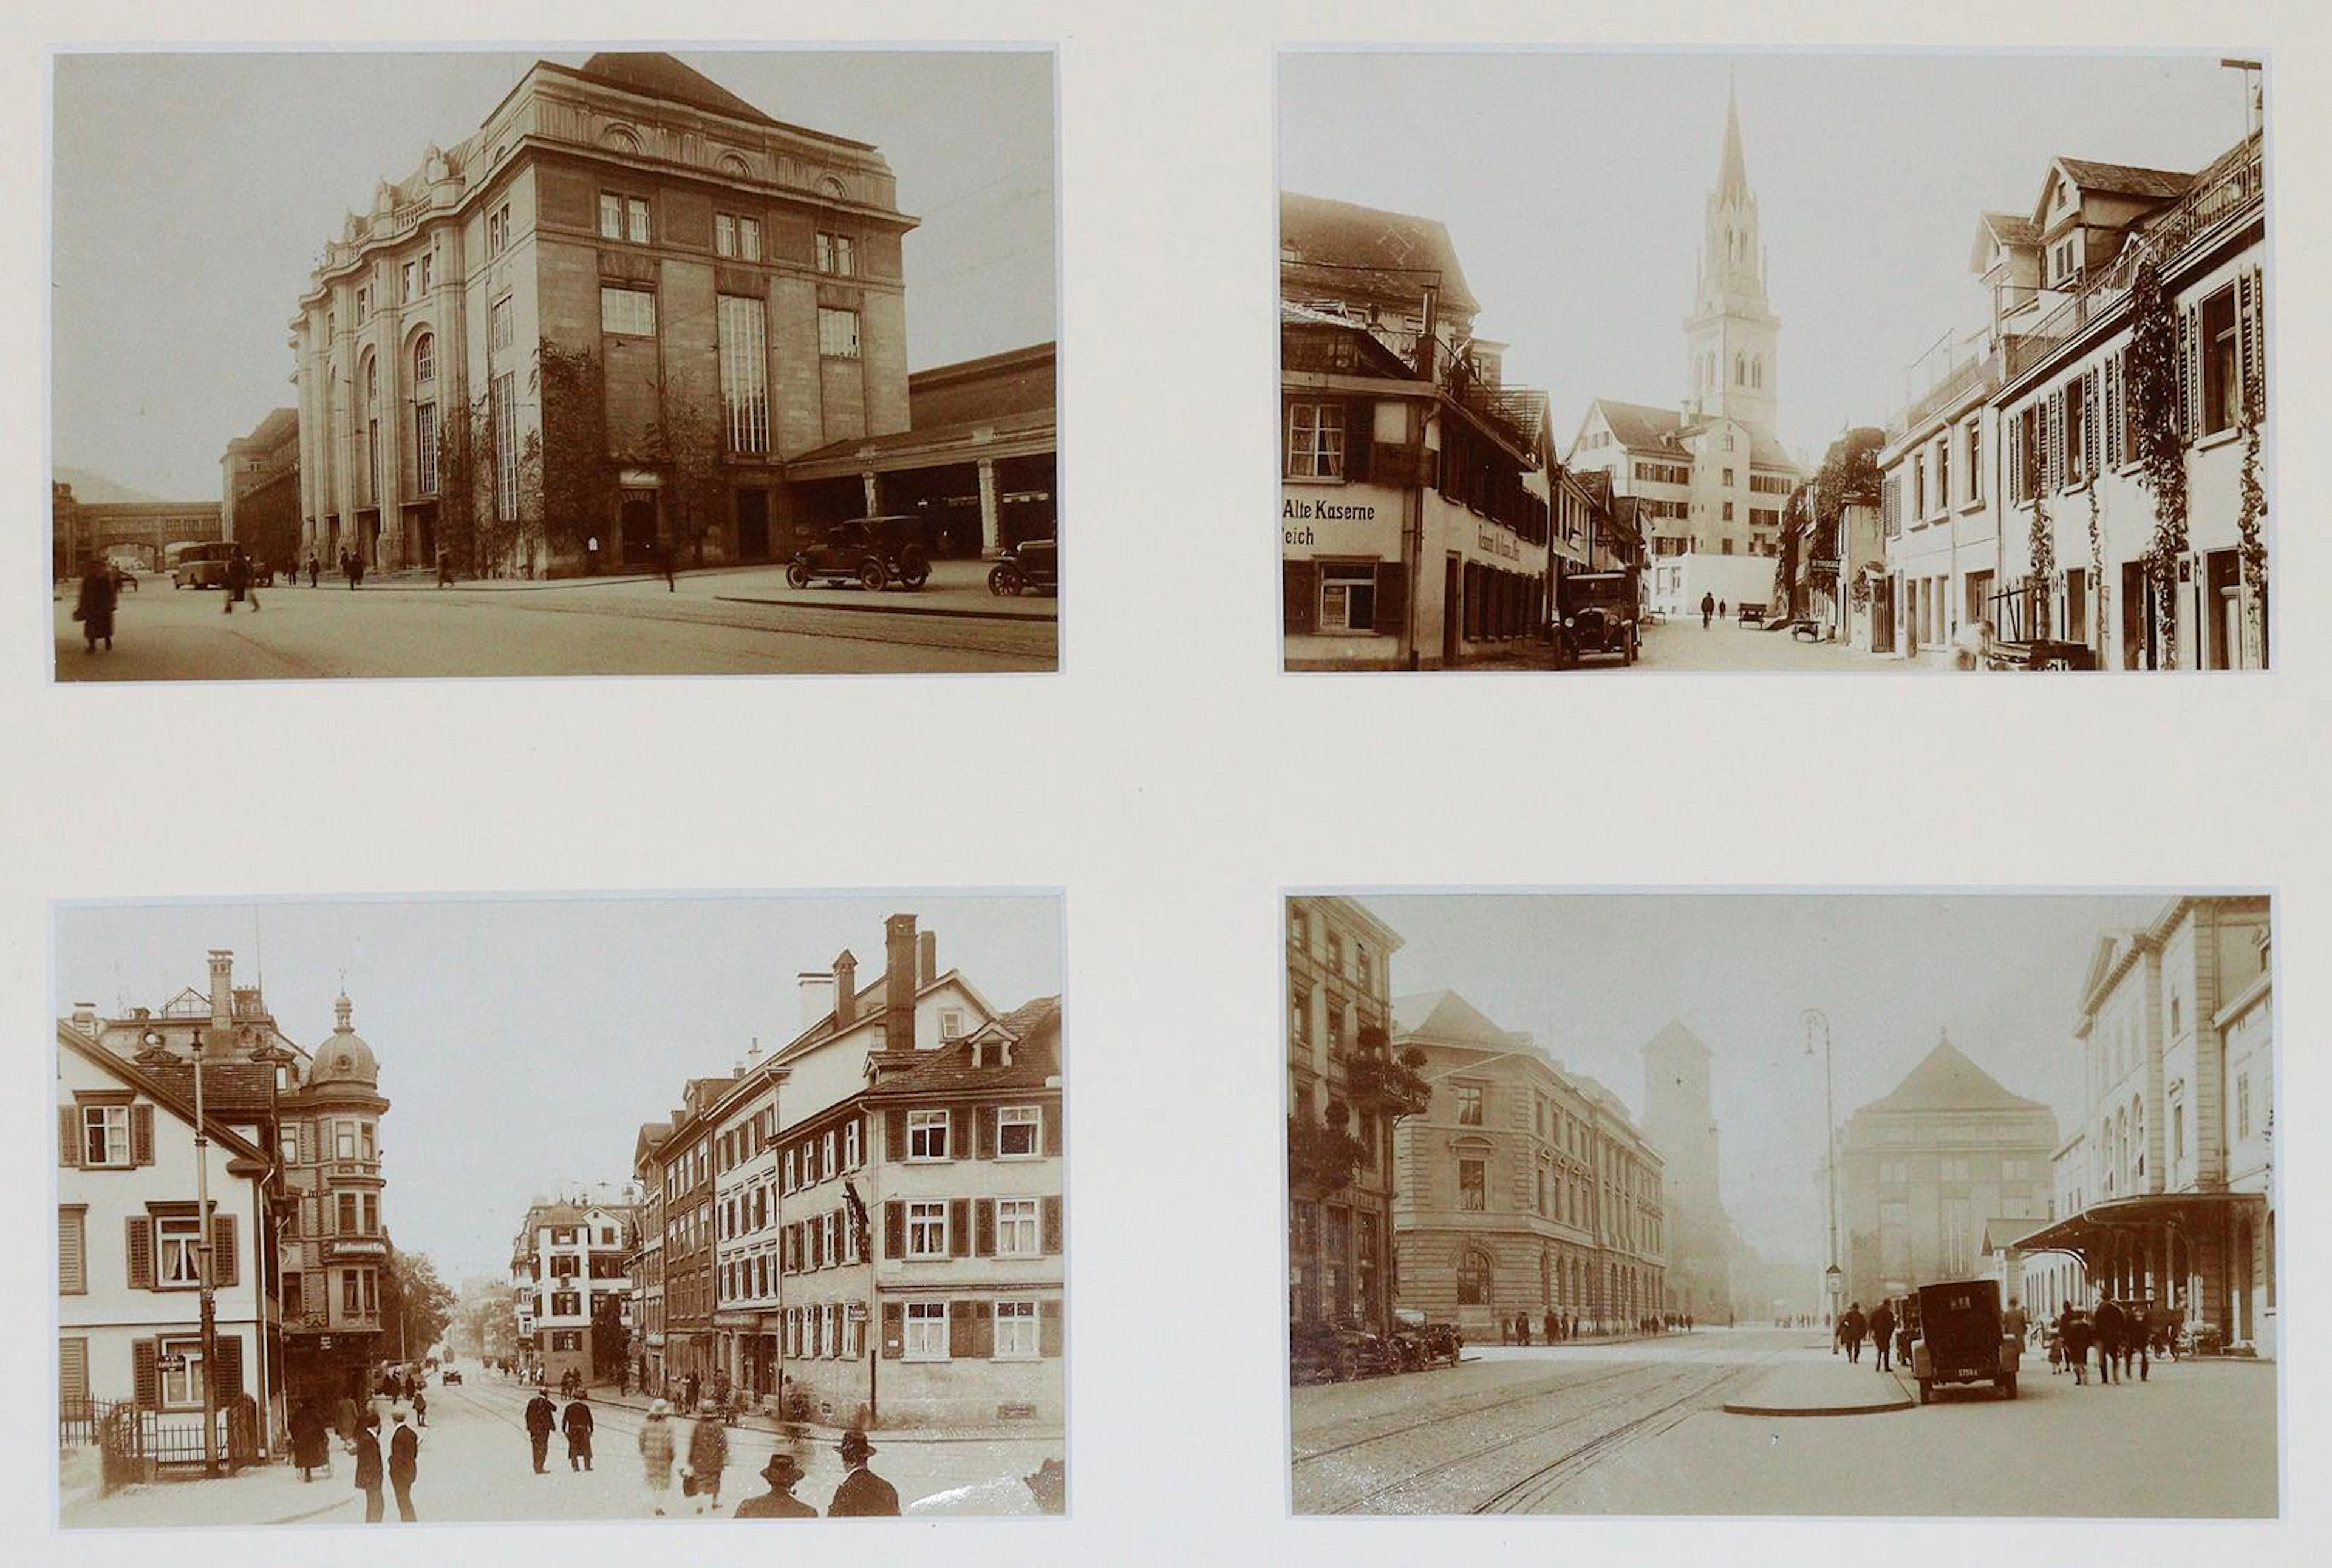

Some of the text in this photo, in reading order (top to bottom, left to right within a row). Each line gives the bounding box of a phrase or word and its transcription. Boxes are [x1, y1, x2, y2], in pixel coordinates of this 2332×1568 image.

[1283, 499, 1375, 520] Alte Kaserne
[1283, 526, 1314, 545] eich
